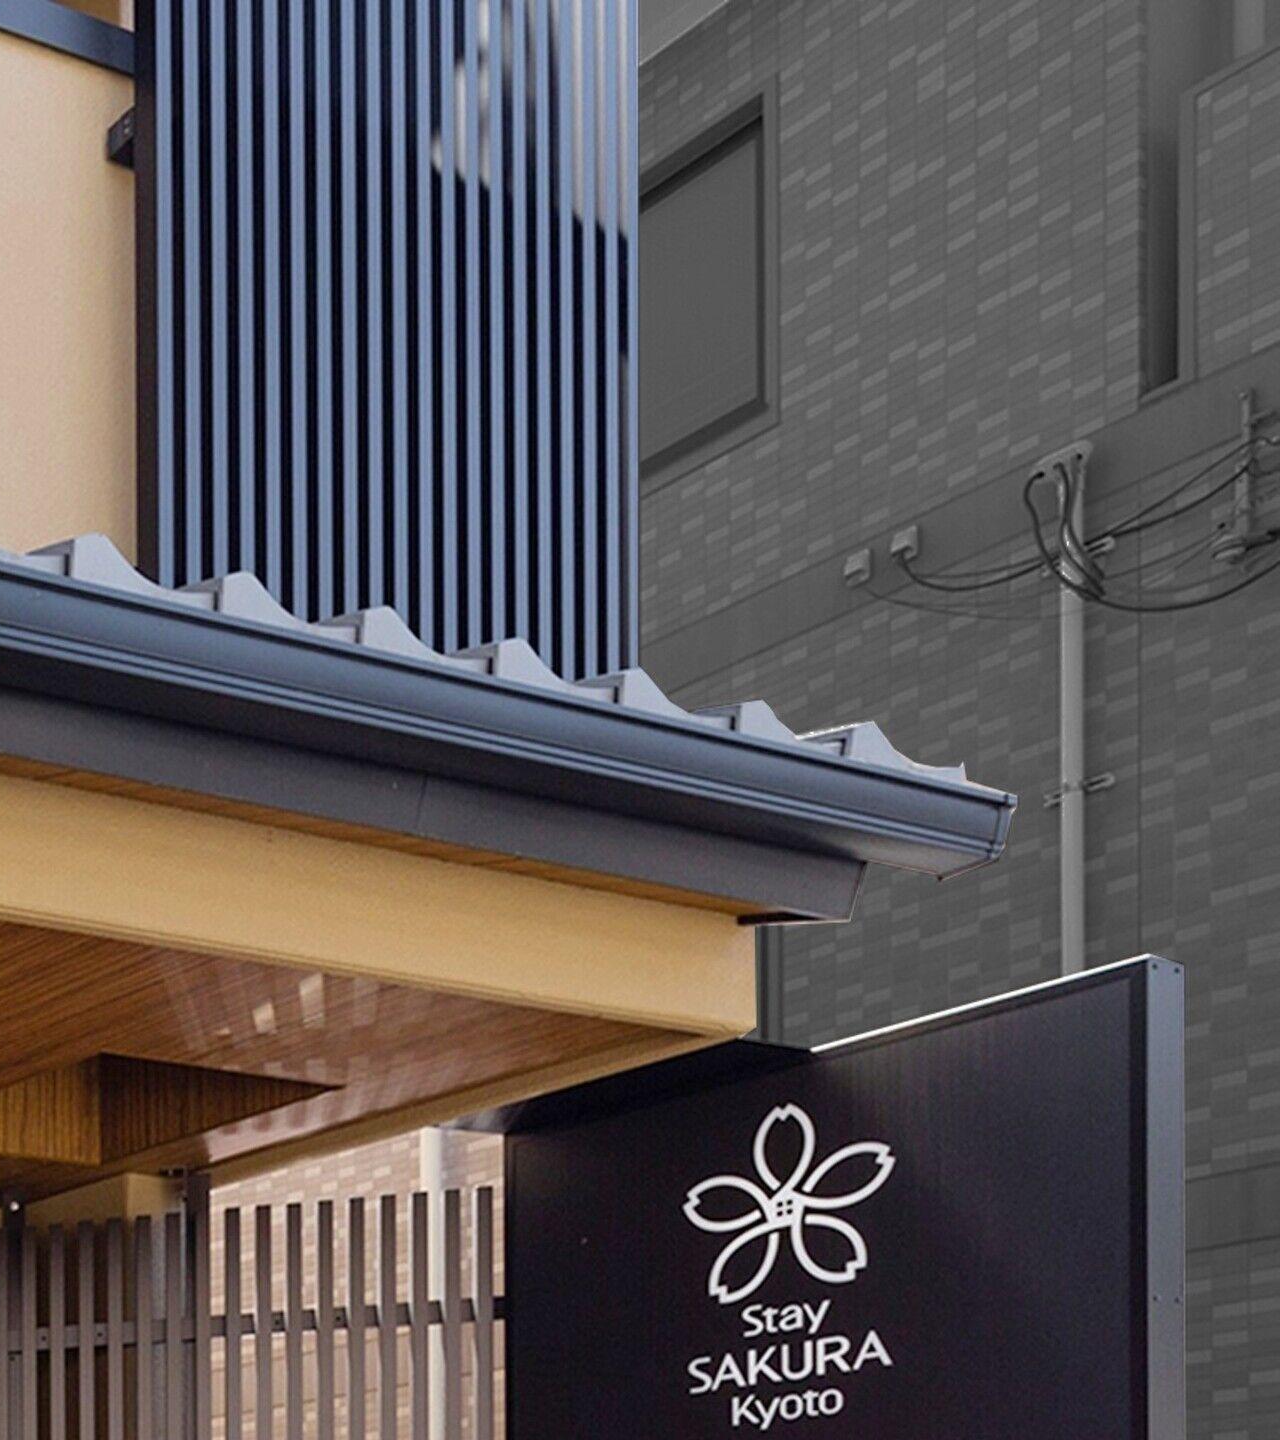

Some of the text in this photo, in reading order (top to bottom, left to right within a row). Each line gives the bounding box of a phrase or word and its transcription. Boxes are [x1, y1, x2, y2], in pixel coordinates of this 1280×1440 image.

[741, 1299, 832, 1338] Stay
[686, 1329, 893, 1395] SAKURA
[730, 1388, 845, 1431] Kyoto
